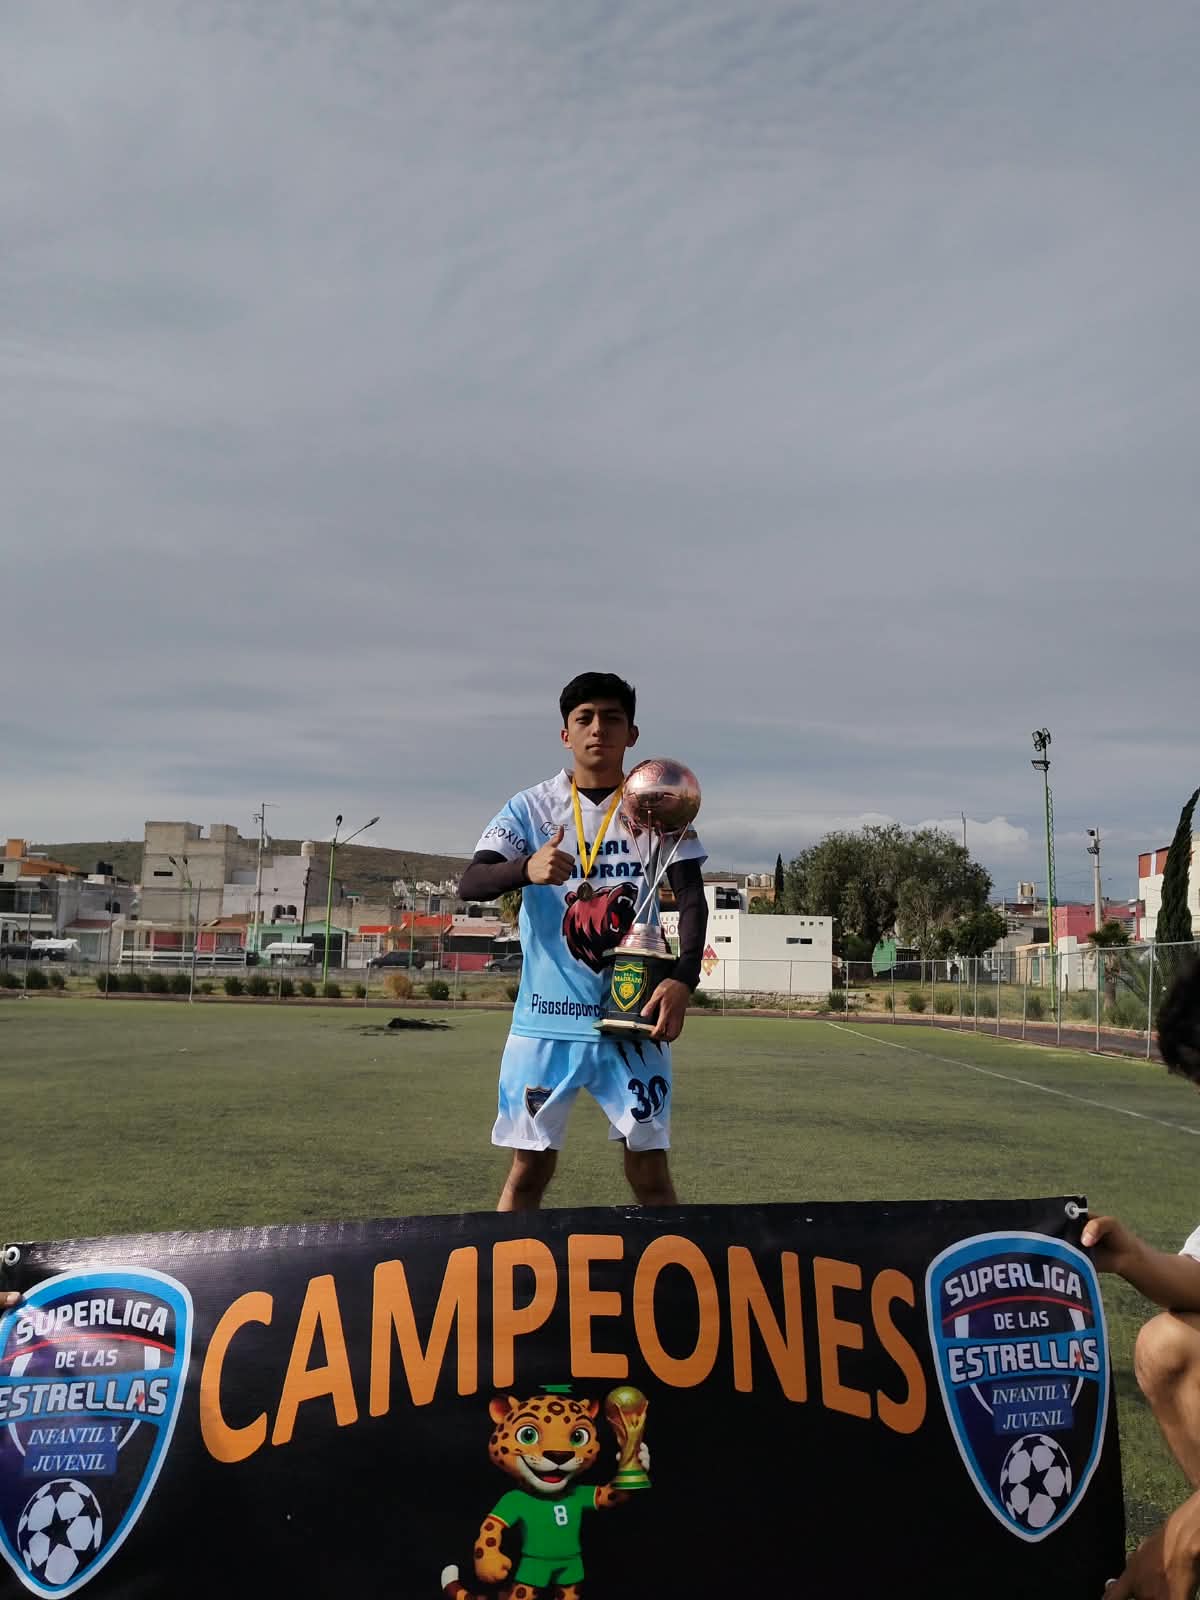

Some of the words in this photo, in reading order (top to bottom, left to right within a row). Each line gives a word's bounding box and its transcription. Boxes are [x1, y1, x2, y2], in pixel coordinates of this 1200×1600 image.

[627, 1075, 669, 1124] 30
[945, 1262, 1083, 1307] SUPERLIGA
[15, 1297, 170, 1346] SUPERLIGA
[993, 1312, 1016, 1330] DE
[1018, 1310, 1050, 1329] LAS
[54, 1351, 76, 1369] DE
[80, 1349, 119, 1369] LAS
[199, 1233, 927, 1464] CAMPEONES
[947, 1338, 1100, 1383] ESTRELLAS
[992, 1386, 1060, 1406] INFANTIL
[1060, 1383, 1072, 1400] Y
[1002, 1410, 1065, 1430] JUVENIL
[27, 1427, 109, 1446] INFANTIL
[109, 1425, 124, 1444] Y
[32, 1453, 107, 1474] JUVENIL
[554, 1505, 569, 1527] 8
